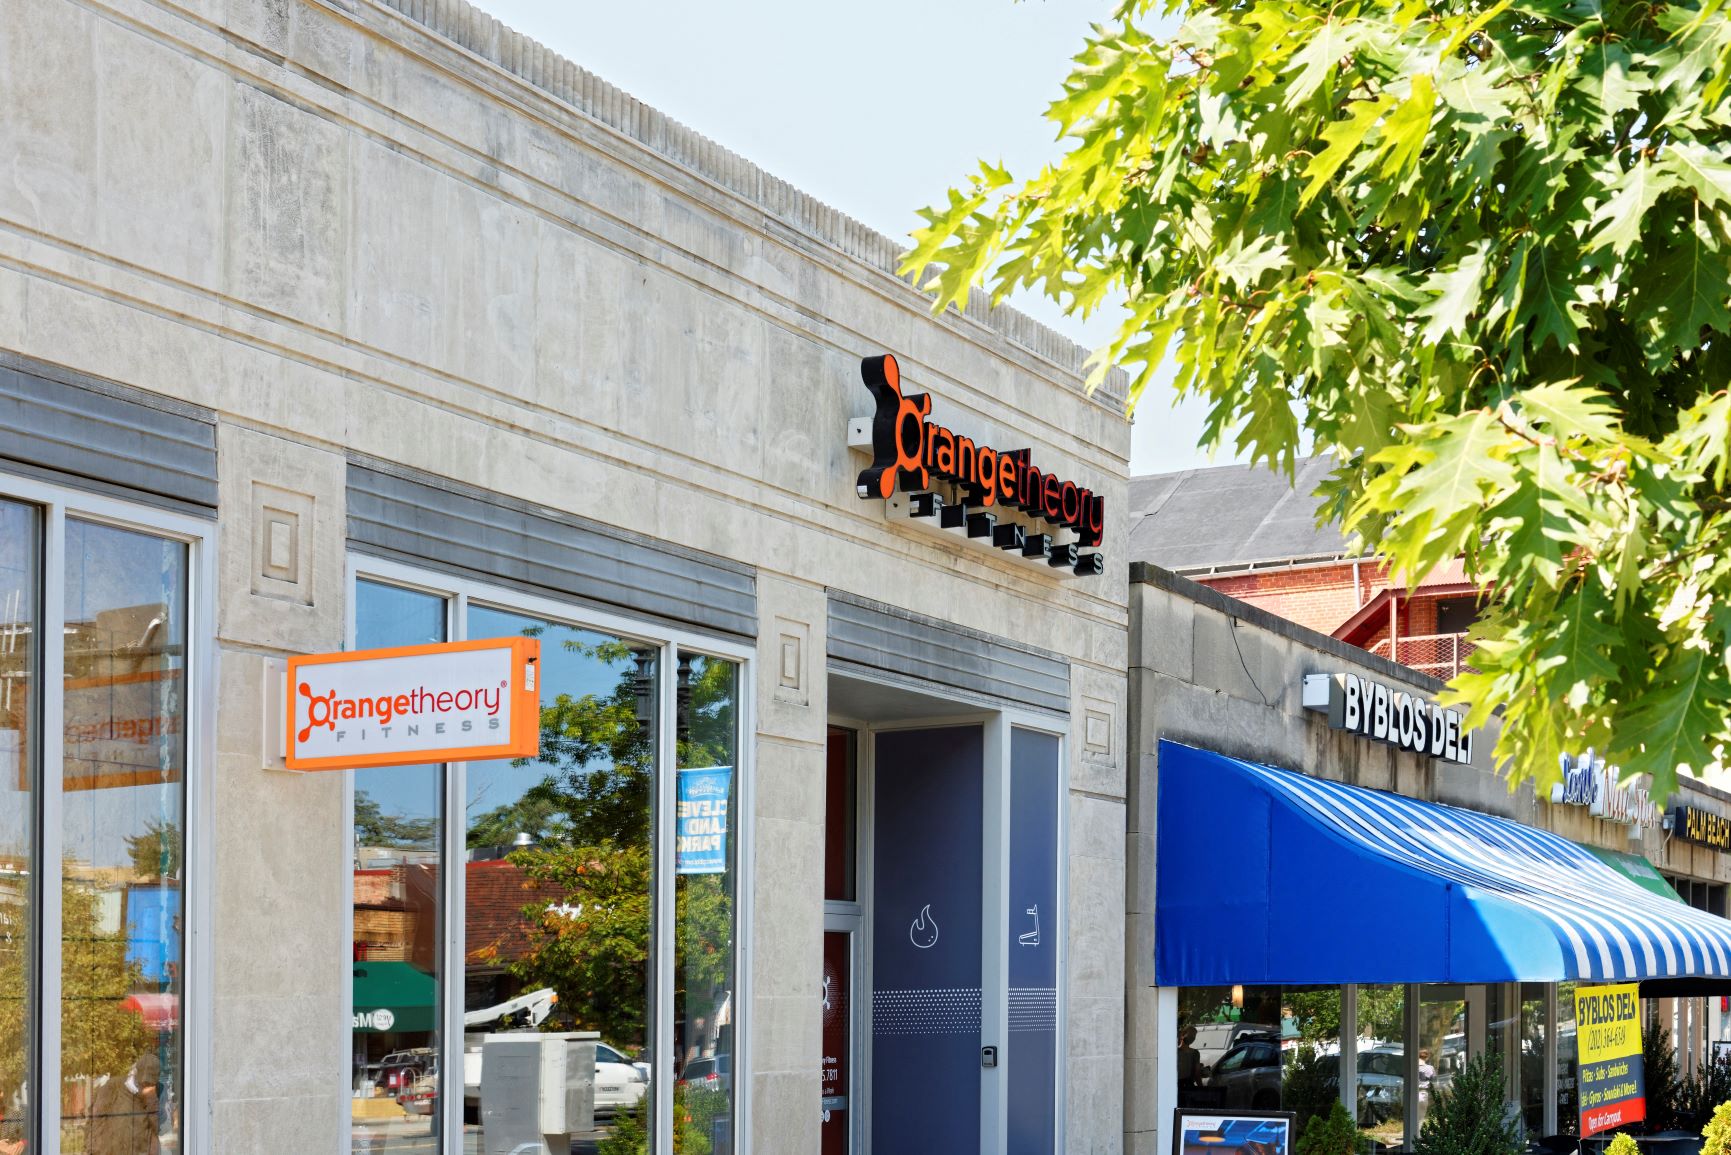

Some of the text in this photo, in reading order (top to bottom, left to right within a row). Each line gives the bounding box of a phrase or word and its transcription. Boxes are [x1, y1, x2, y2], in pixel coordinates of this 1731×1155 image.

[932, 493, 1104, 575] FITNESS
[336, 717, 500, 742] FITNESS
[1345, 673, 1473, 765] BYBLOS DELI
[1686, 806, 1730, 849] PALM BEACH
[1579, 994, 1615, 1026] BYBLOS
